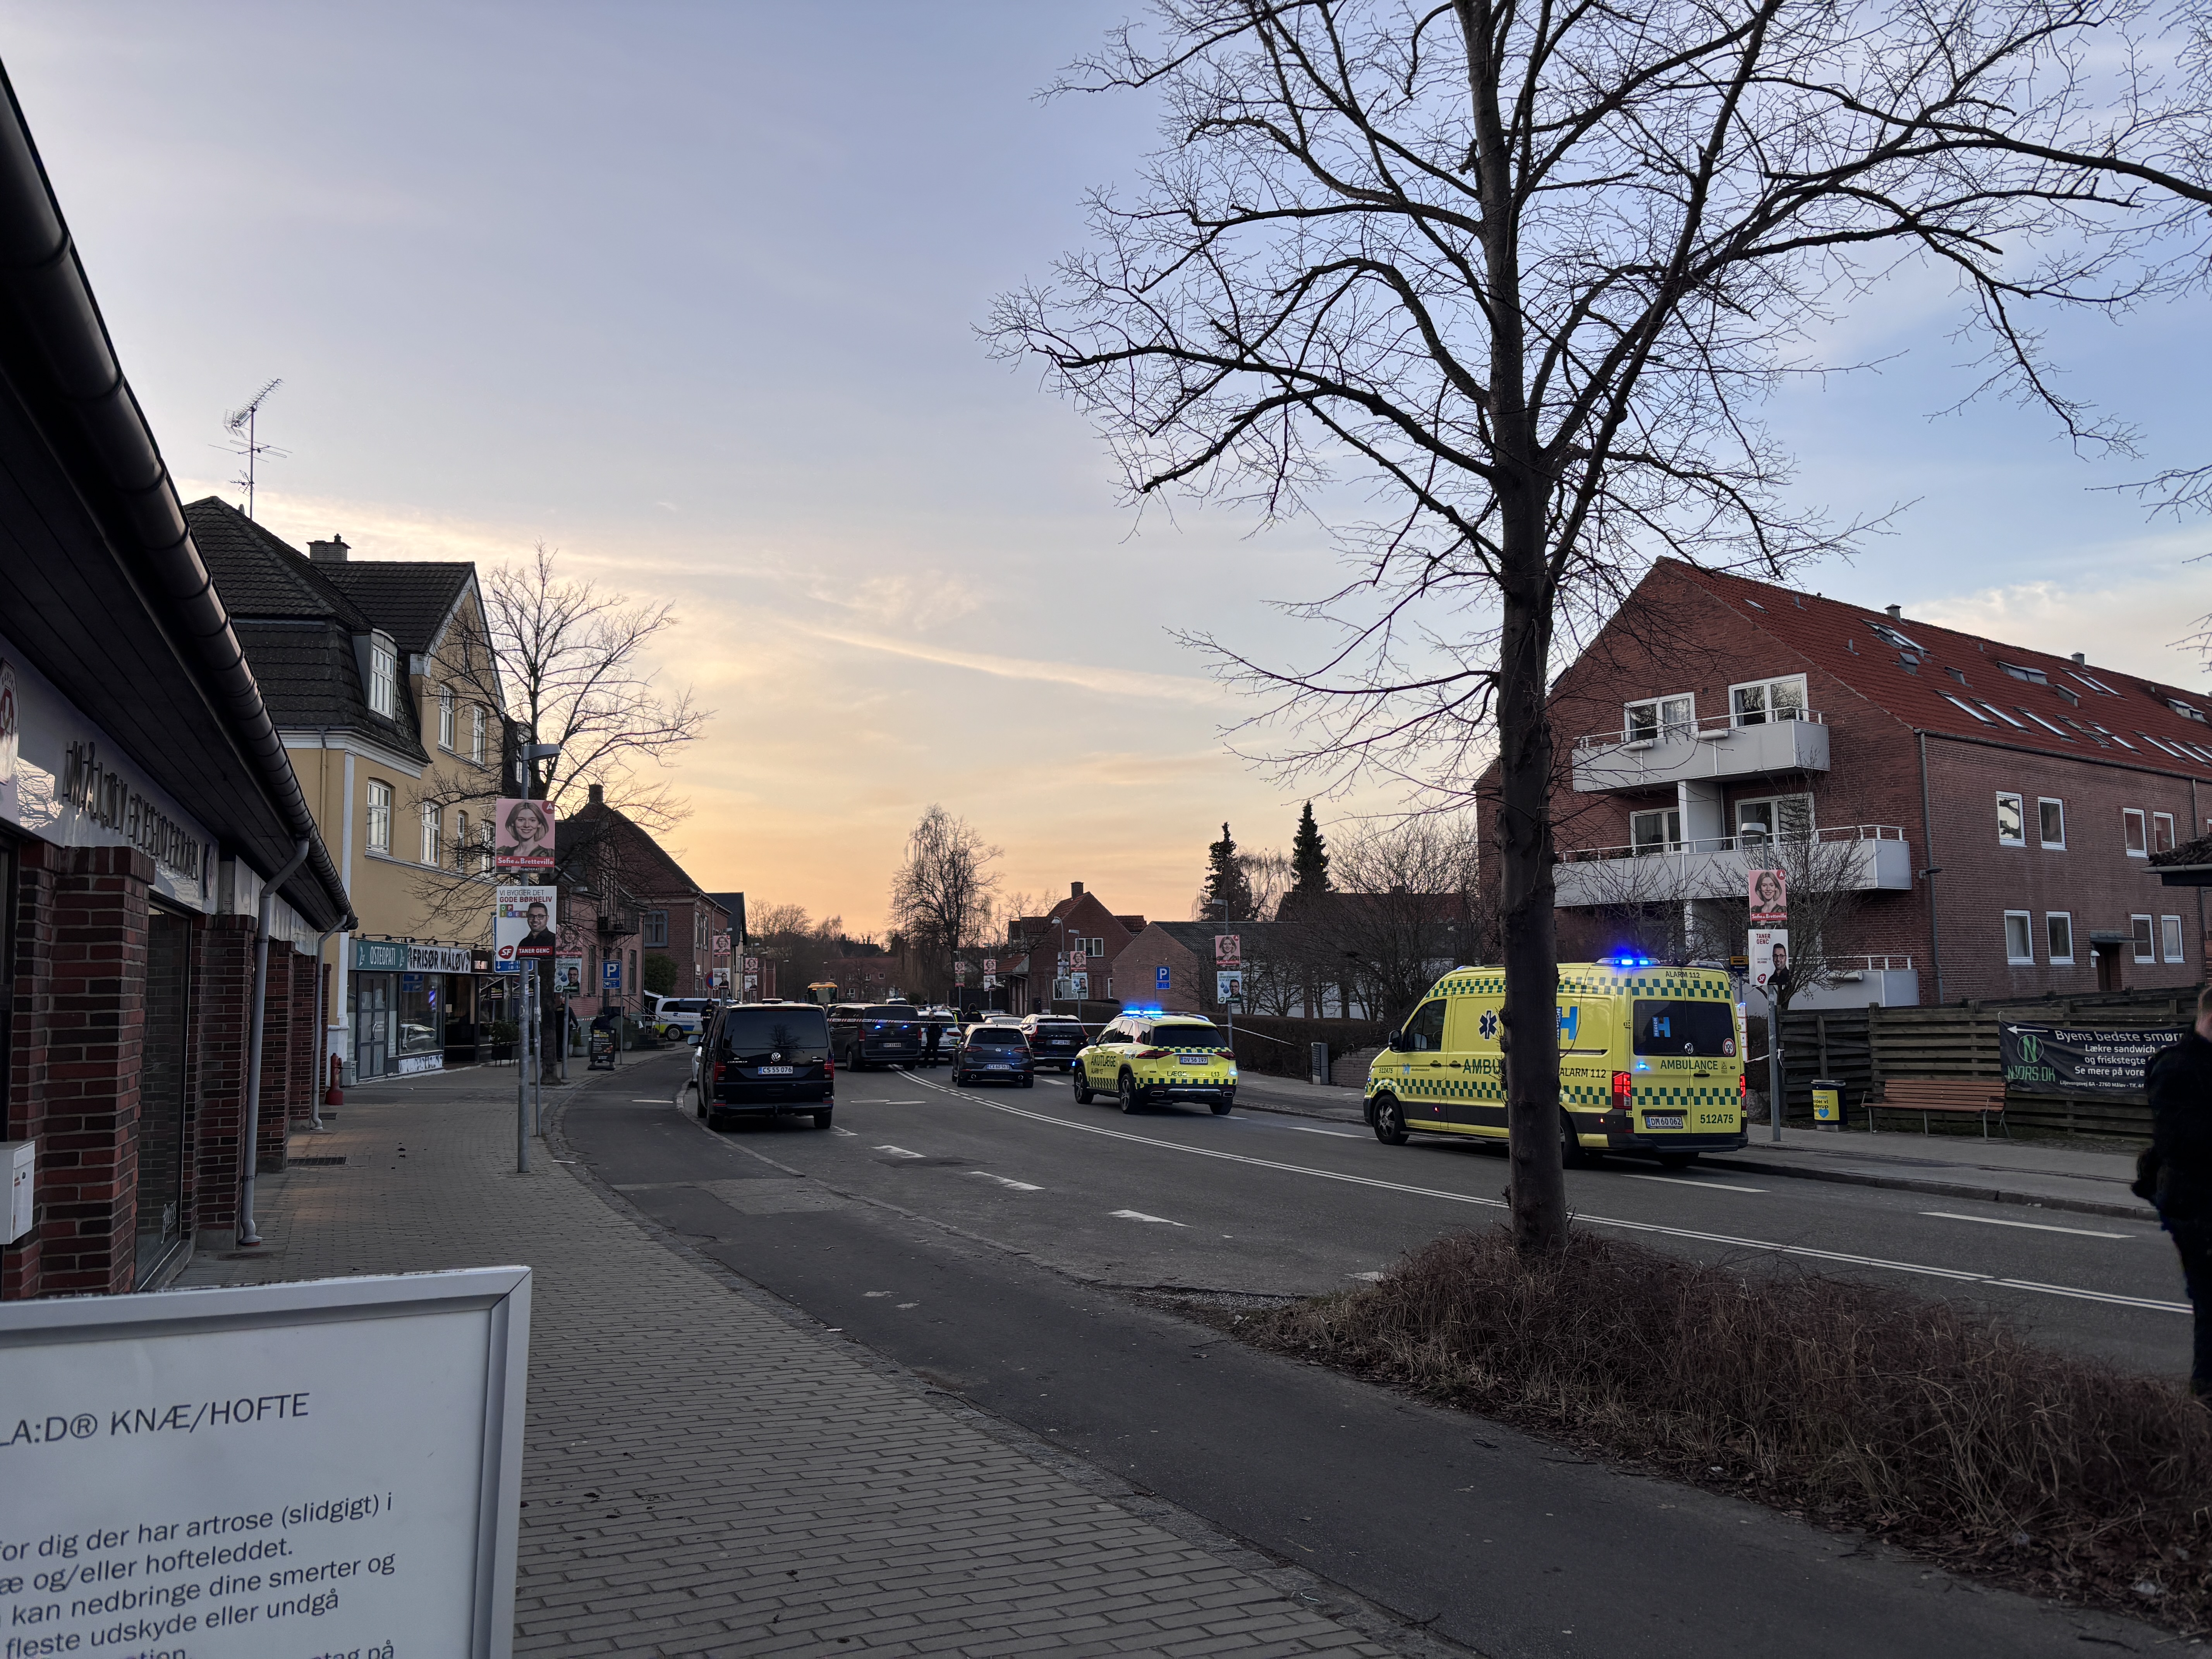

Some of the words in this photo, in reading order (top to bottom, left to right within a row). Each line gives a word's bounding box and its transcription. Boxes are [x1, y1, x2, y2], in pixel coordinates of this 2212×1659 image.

[370, 946, 395, 965] OSTEOPATI
[413, 950, 438, 969] FRISØR
[441, 947, 465, 972] MÅLØV
[607, 963, 617, 977] P
[1159, 968, 1167, 979] P
[2054, 1030, 2093, 1043] Byens
[2096, 1031, 2140, 1042] bedste
[2023, 1036, 2037, 1063] N
[2085, 1044, 2112, 1053] Lækre
[2114, 1044, 2155, 1053] sandwich
[1091, 1054, 1116, 1067] AKUTLÆGE
[1660, 1060, 1718, 1070] AMBULANCE
[2085, 1057, 2095, 1065] og
[2097, 1056, 2146, 1065] friskstegte
[1559, 1068, 1588, 1077] ALARM
[1590, 1069, 1606, 1079] 112
[2075, 1066, 2085, 1074] Se
[2112, 1066, 2123, 1077] på
[1669, 1118, 1681, 1126] 062
[1700, 1114, 1734, 1124] 512A75
[111, 1393, 310, 1436] KNÆ/HOFTE
[0, 1540, 30, 1561] or
[38, 1534, 79, 1558] dig
[86, 1528, 130, 1551] der
[138, 1522, 180, 1544] har
[186, 1511, 273, 1539] artrose
[282, 1494, 380, 1530] (slidgigt)
[387, 1492, 393, 1511] i
[34, 1561, 137, 1592] og/eller
[146, 1539, 293, 1575] hofteleddet.
[12, 1605, 60, 1627] kan
[71, 1585, 201, 1616] nedbringe
[209, 1575, 261, 1597] dine
[268, 1559, 361, 1587] smerter
[367, 1553, 396, 1575] og
[6, 1633, 81, 1659] fleste
[91, 1607, 198, 1647] udskyde
[205, 1605, 259, 1628] eller
[267, 1588, 339, 1617] undgå
